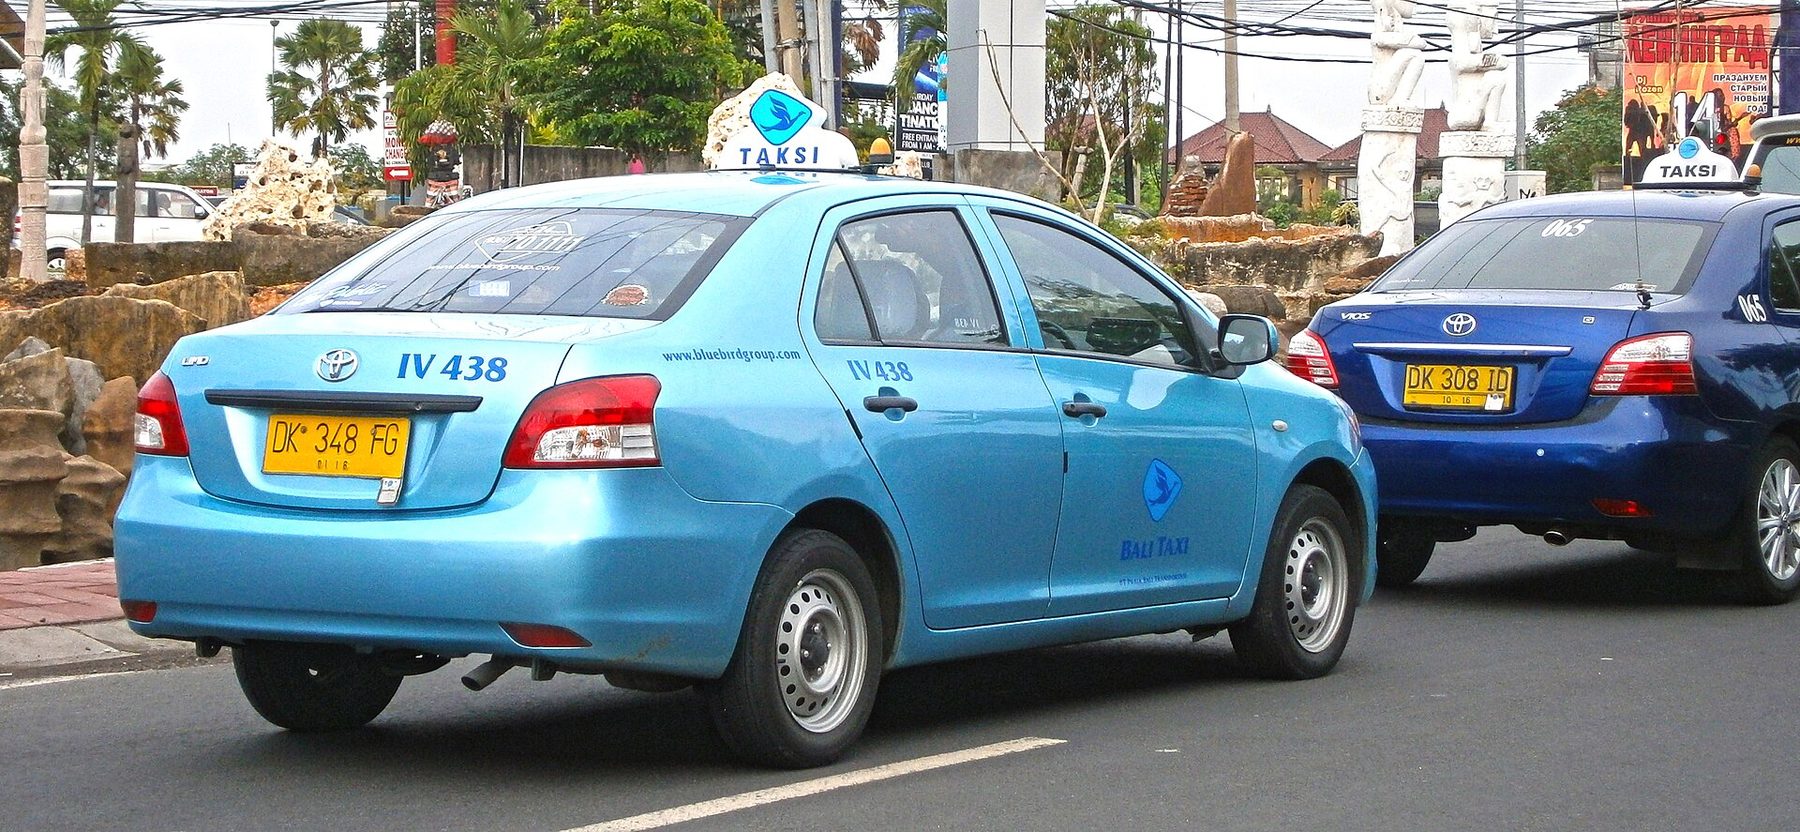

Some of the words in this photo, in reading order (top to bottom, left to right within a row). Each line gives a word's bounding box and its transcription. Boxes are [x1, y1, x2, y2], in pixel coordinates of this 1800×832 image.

[1713, 74, 1767, 83] ПРАЗДНУЕМ
[1730, 84, 1767, 92] СТАРЫЙ
[1733, 94, 1767, 102] НОВЫЙ
[1747, 104, 1768, 113] ГОД!
[902, 132, 916, 141] FREE
[901, 140, 918, 149] FROM
[739, 146, 819, 165] TAKSI
[1660, 164, 1717, 178] TAKSI
[1541, 218, 1595, 237] 065
[1341, 311, 1372, 320] VIOS
[1737, 294, 1767, 323] 065
[662, 348, 801, 363] www.bluebirdgroup.com
[396, 353, 437, 379] IV
[440, 354, 508, 382] 438
[847, 359, 871, 381] IV
[875, 360, 913, 382] 438
[1408, 367, 1435, 390] DK
[1441, 368, 1479, 390] 308
[1487, 369, 1509, 391] ID
[272, 420, 302, 453] DK
[314, 422, 359, 454] 348
[371, 423, 399, 455] FG
[1120, 540, 1154, 561] BALI
[1157, 535, 1190, 556] TAXI
